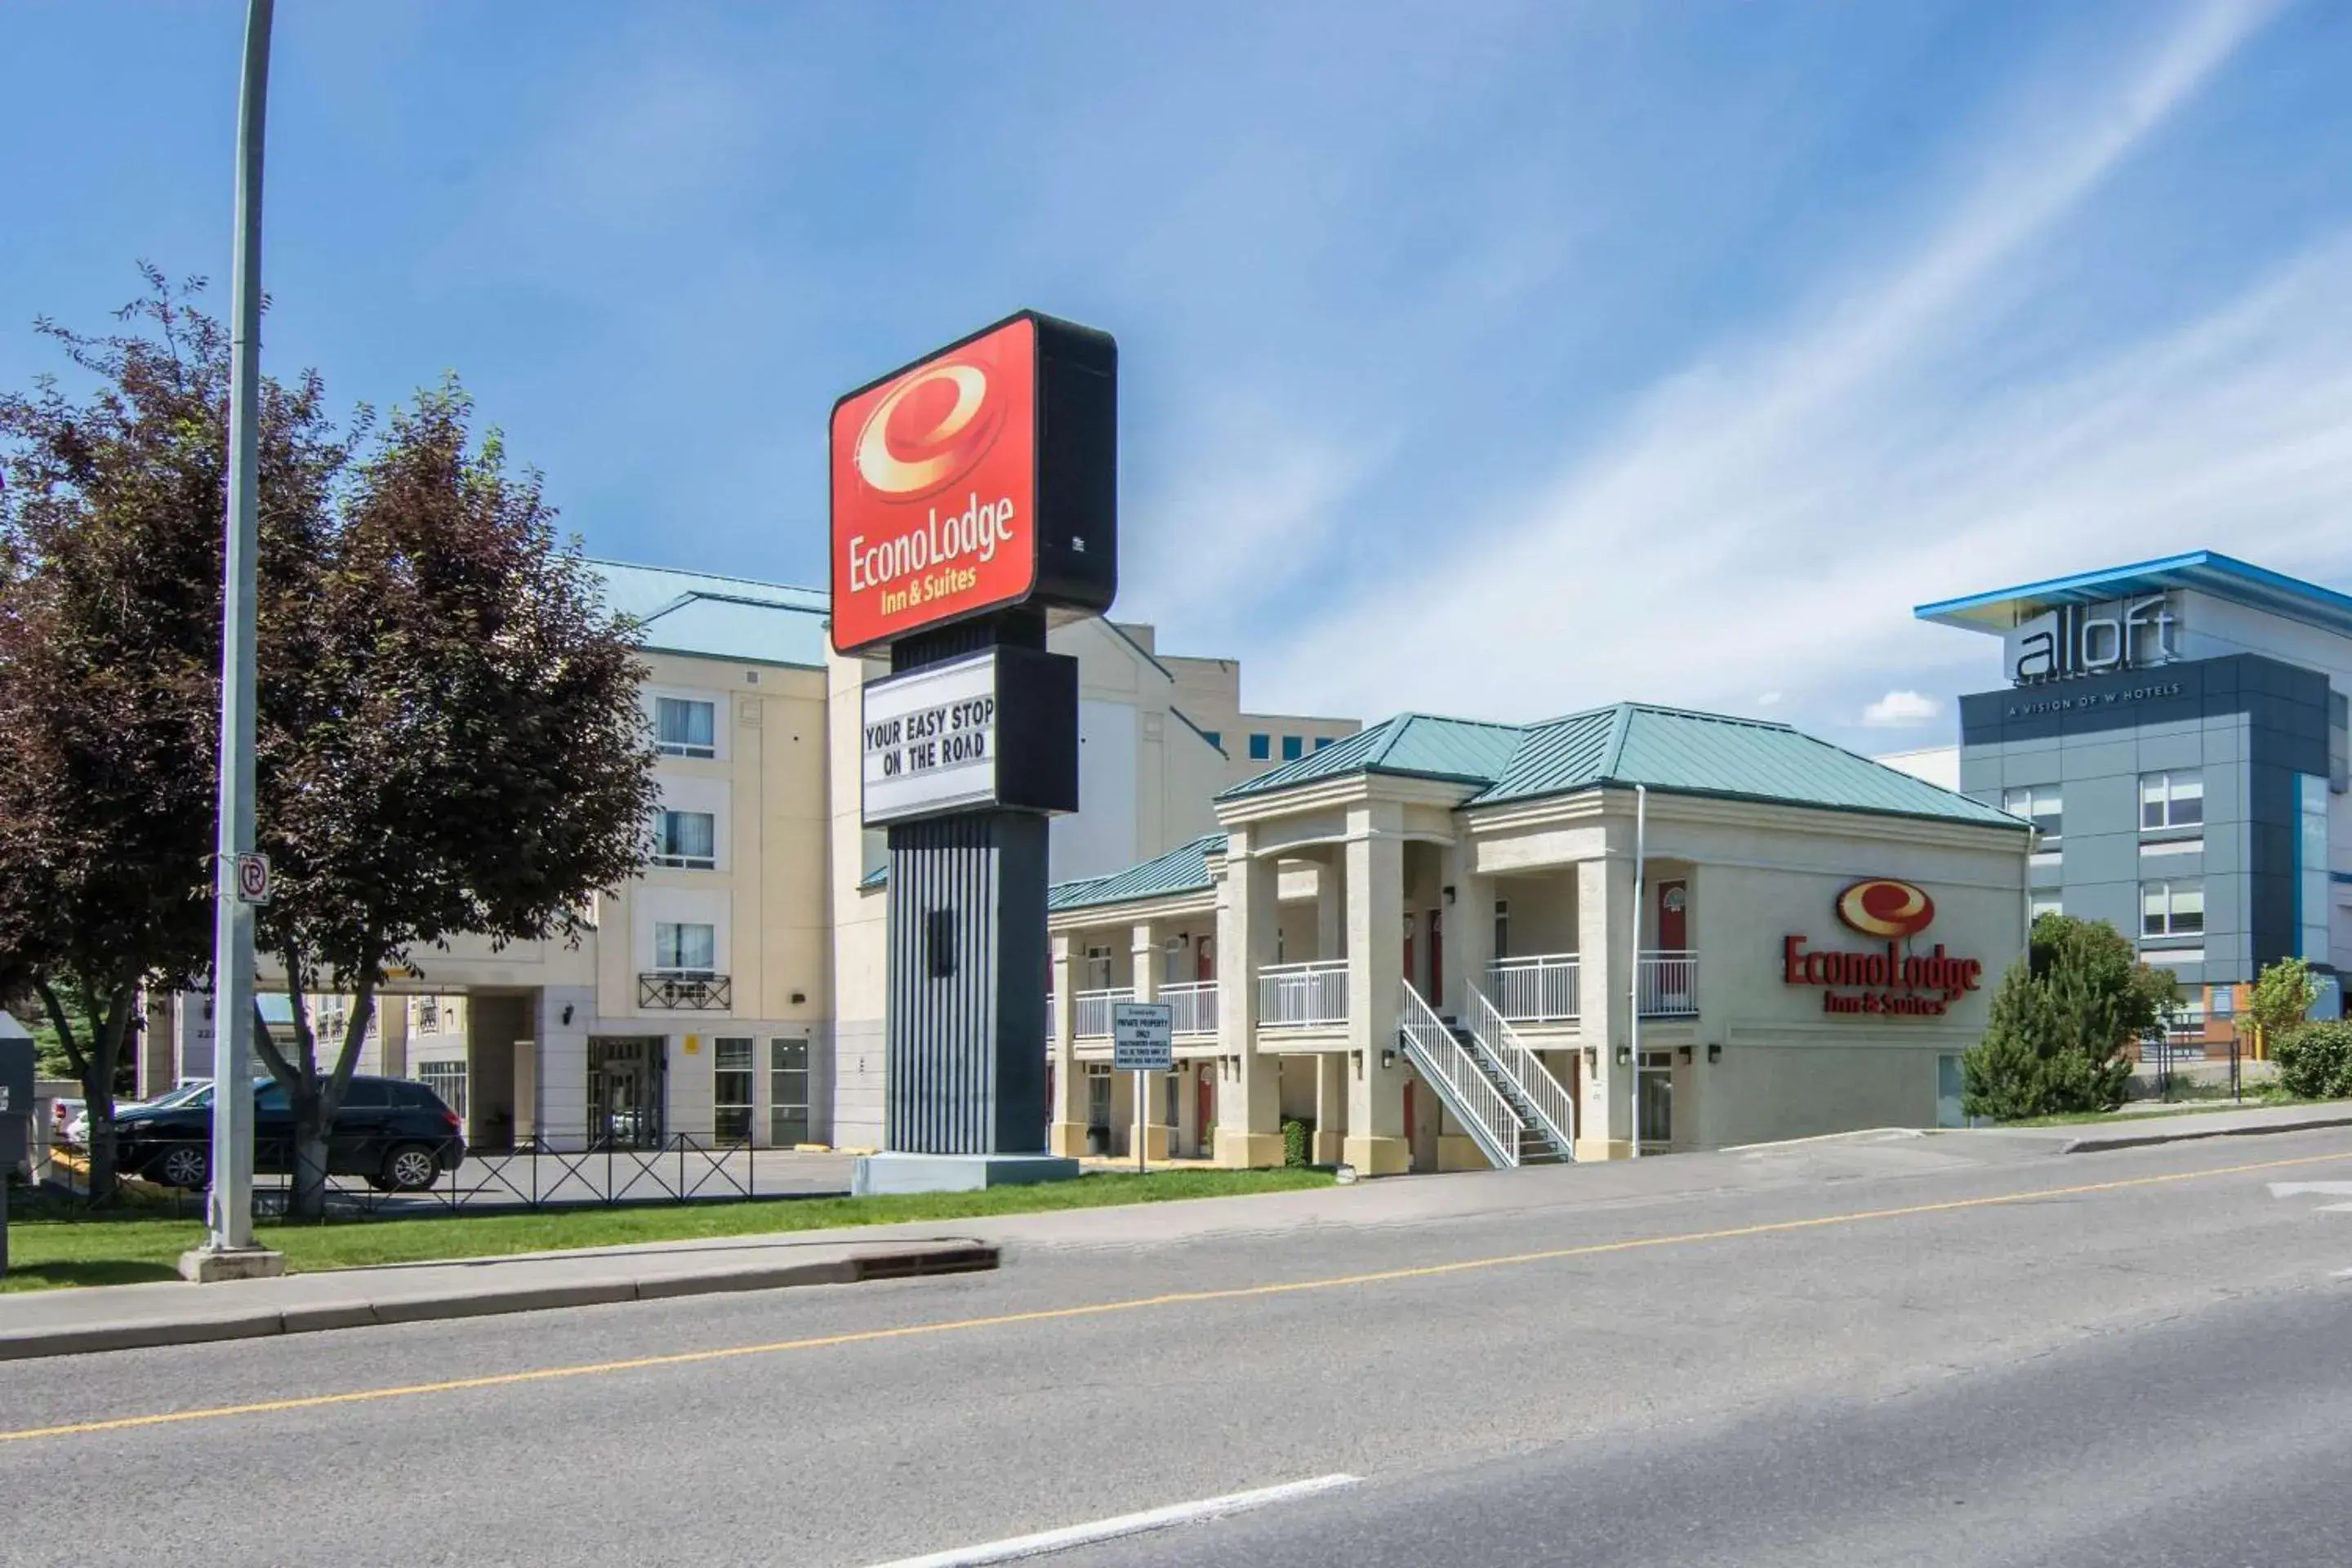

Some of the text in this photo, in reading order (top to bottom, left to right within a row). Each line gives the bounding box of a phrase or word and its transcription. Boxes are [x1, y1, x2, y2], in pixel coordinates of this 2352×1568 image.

[849, 492, 1015, 593] EconoLodge
[880, 566, 977, 616] Inn & Suites
[2017, 595, 2175, 679] aloft
[866, 698, 994, 751] YOUR EASY STOP
[2009, 684, 2181, 716] A VISION OF W HOTELS
[884, 733, 984, 776] ON THE ROAD
[1784, 935, 1981, 1000] EconoLodge
[1824, 991, 1947, 1015] Inn & Suites
